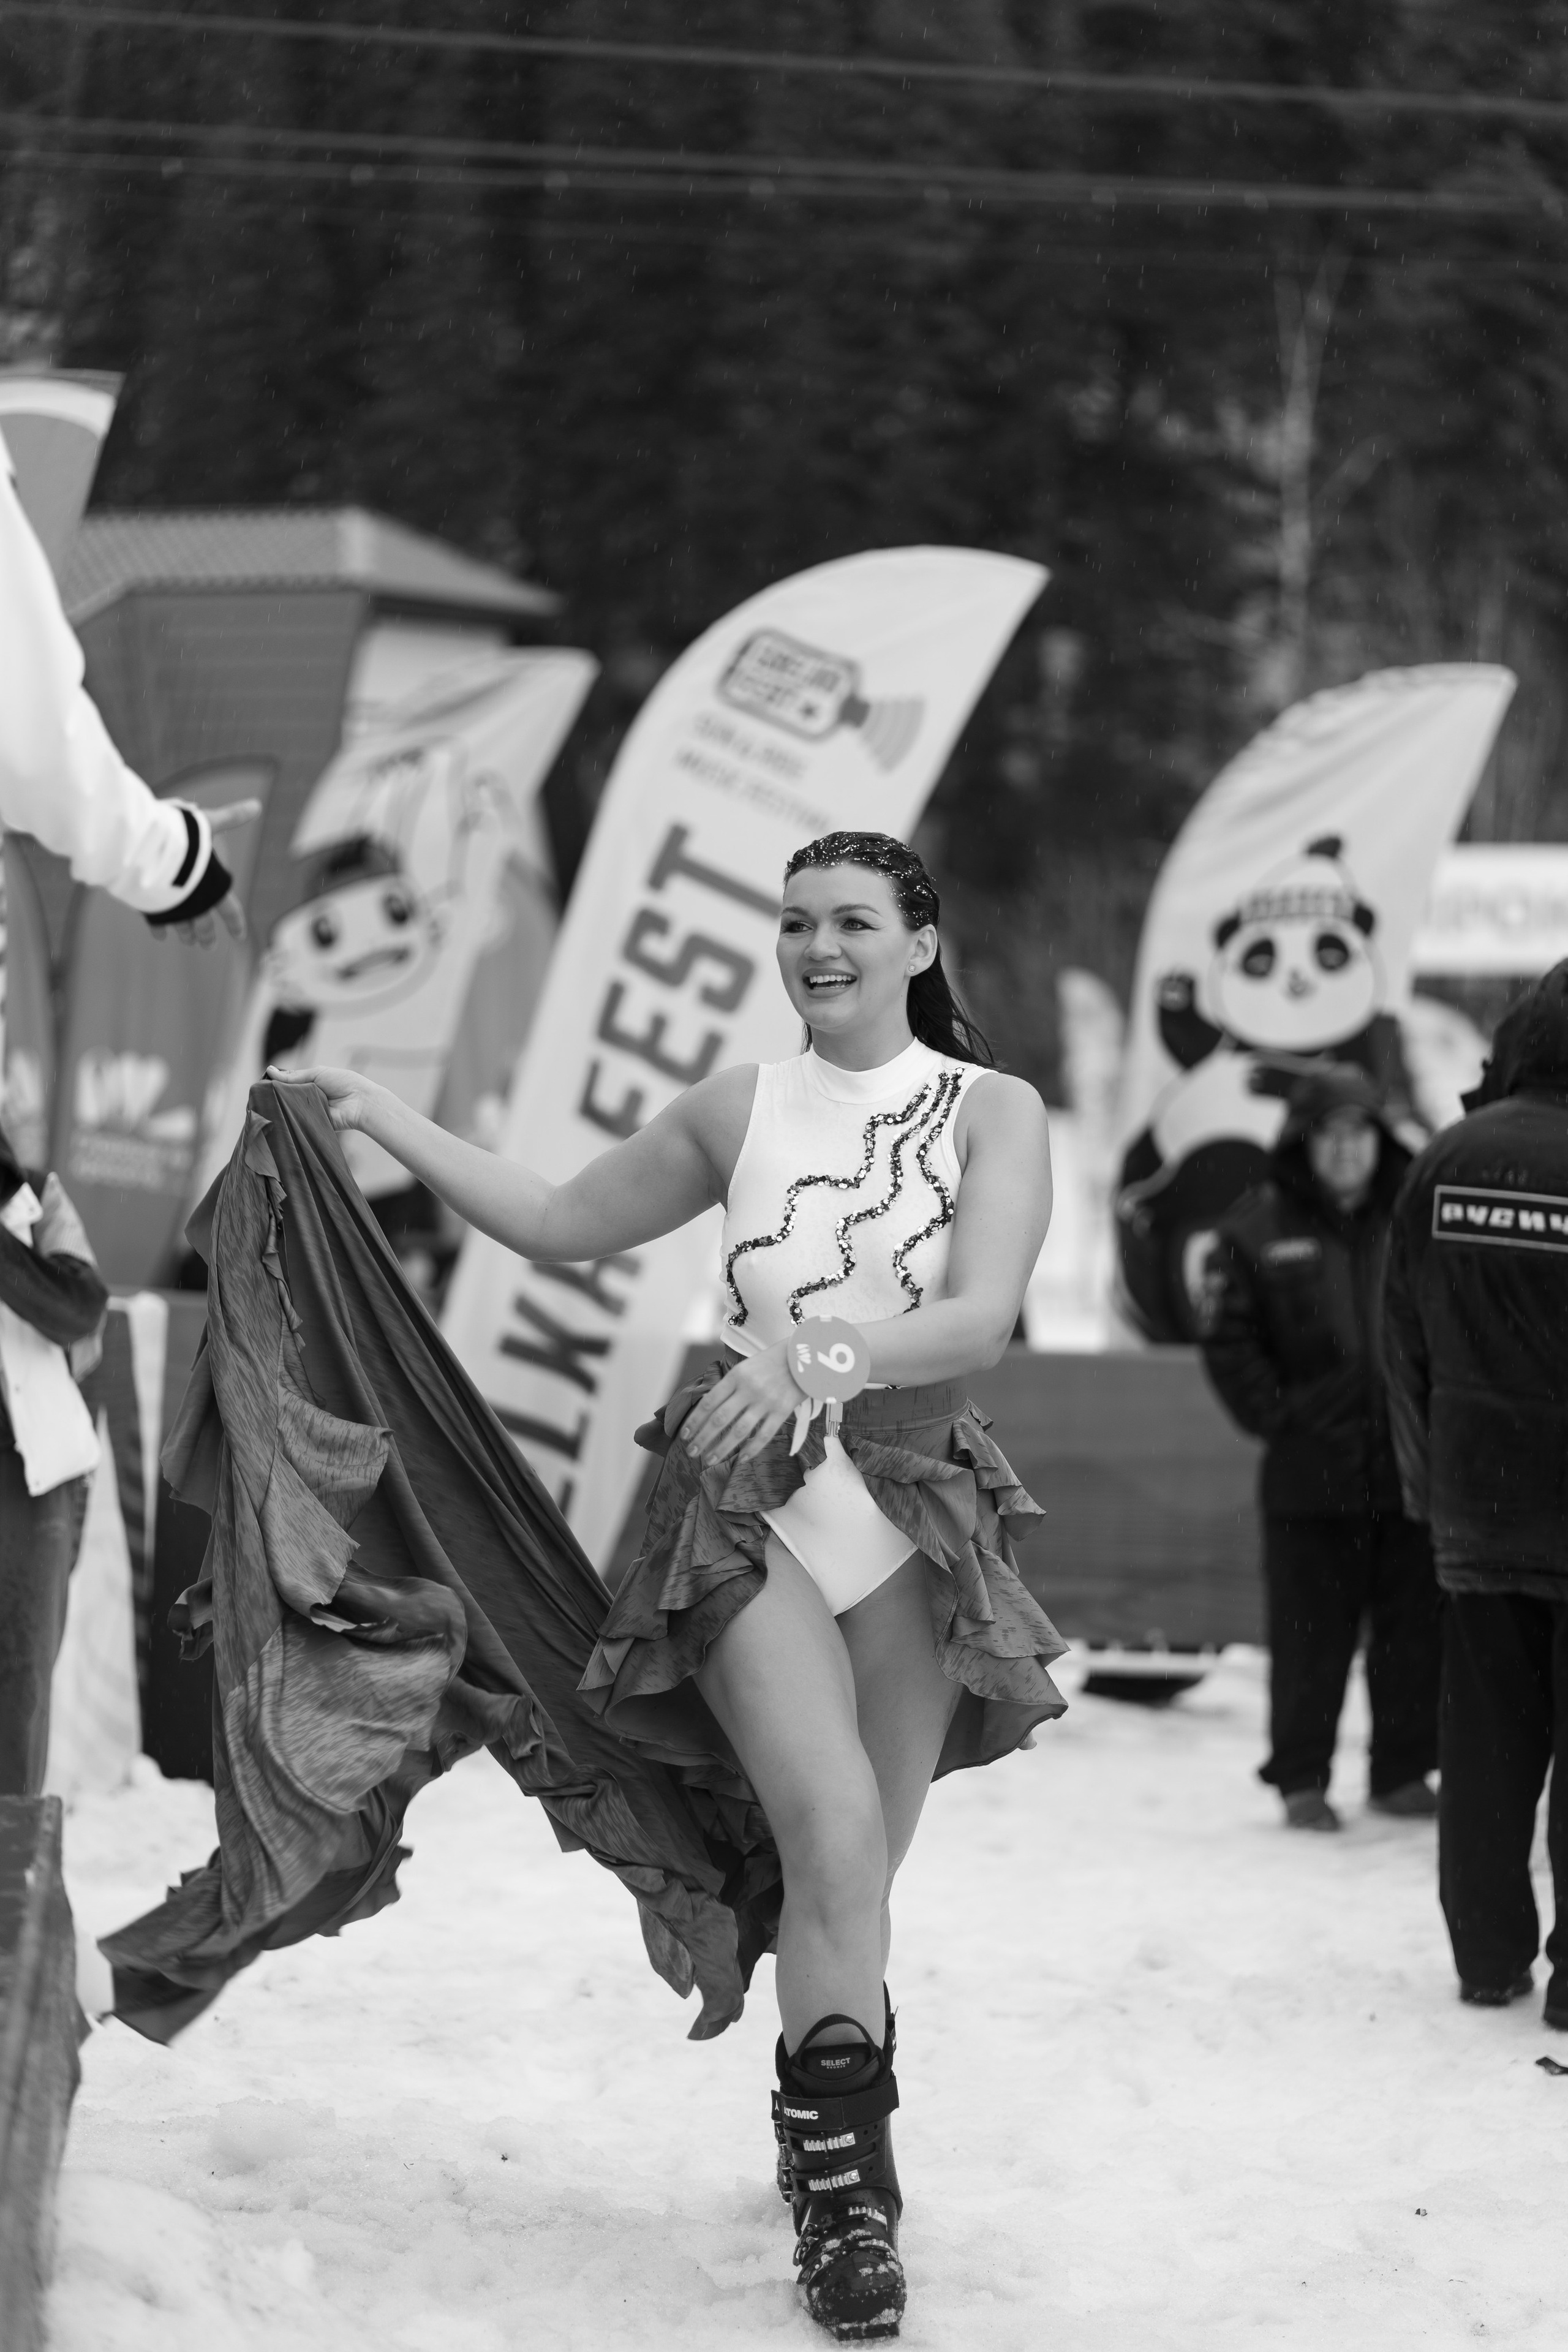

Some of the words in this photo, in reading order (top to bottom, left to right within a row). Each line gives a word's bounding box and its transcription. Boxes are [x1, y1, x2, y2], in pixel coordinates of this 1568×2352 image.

[488, 1253, 641, 1519] LKA
[579, 822, 782, 1139] FEST
[821, 2057, 850, 2066] SELECT
[784, 2106, 819, 2120] ATOMIC
